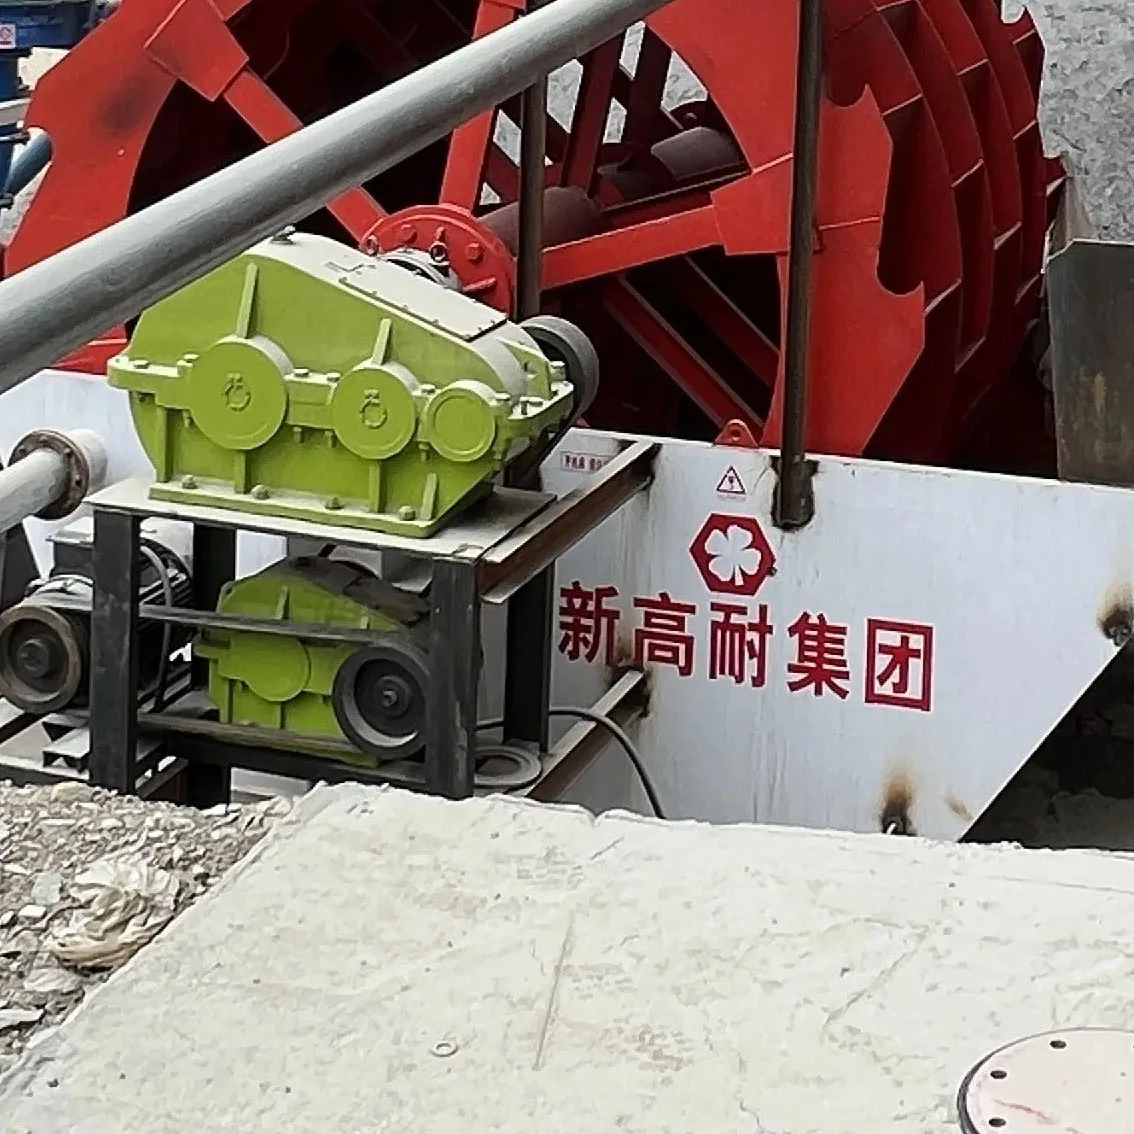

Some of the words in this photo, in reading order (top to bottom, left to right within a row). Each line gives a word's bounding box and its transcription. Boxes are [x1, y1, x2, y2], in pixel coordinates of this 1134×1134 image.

[559, 580, 933, 712] 新高耐集团
